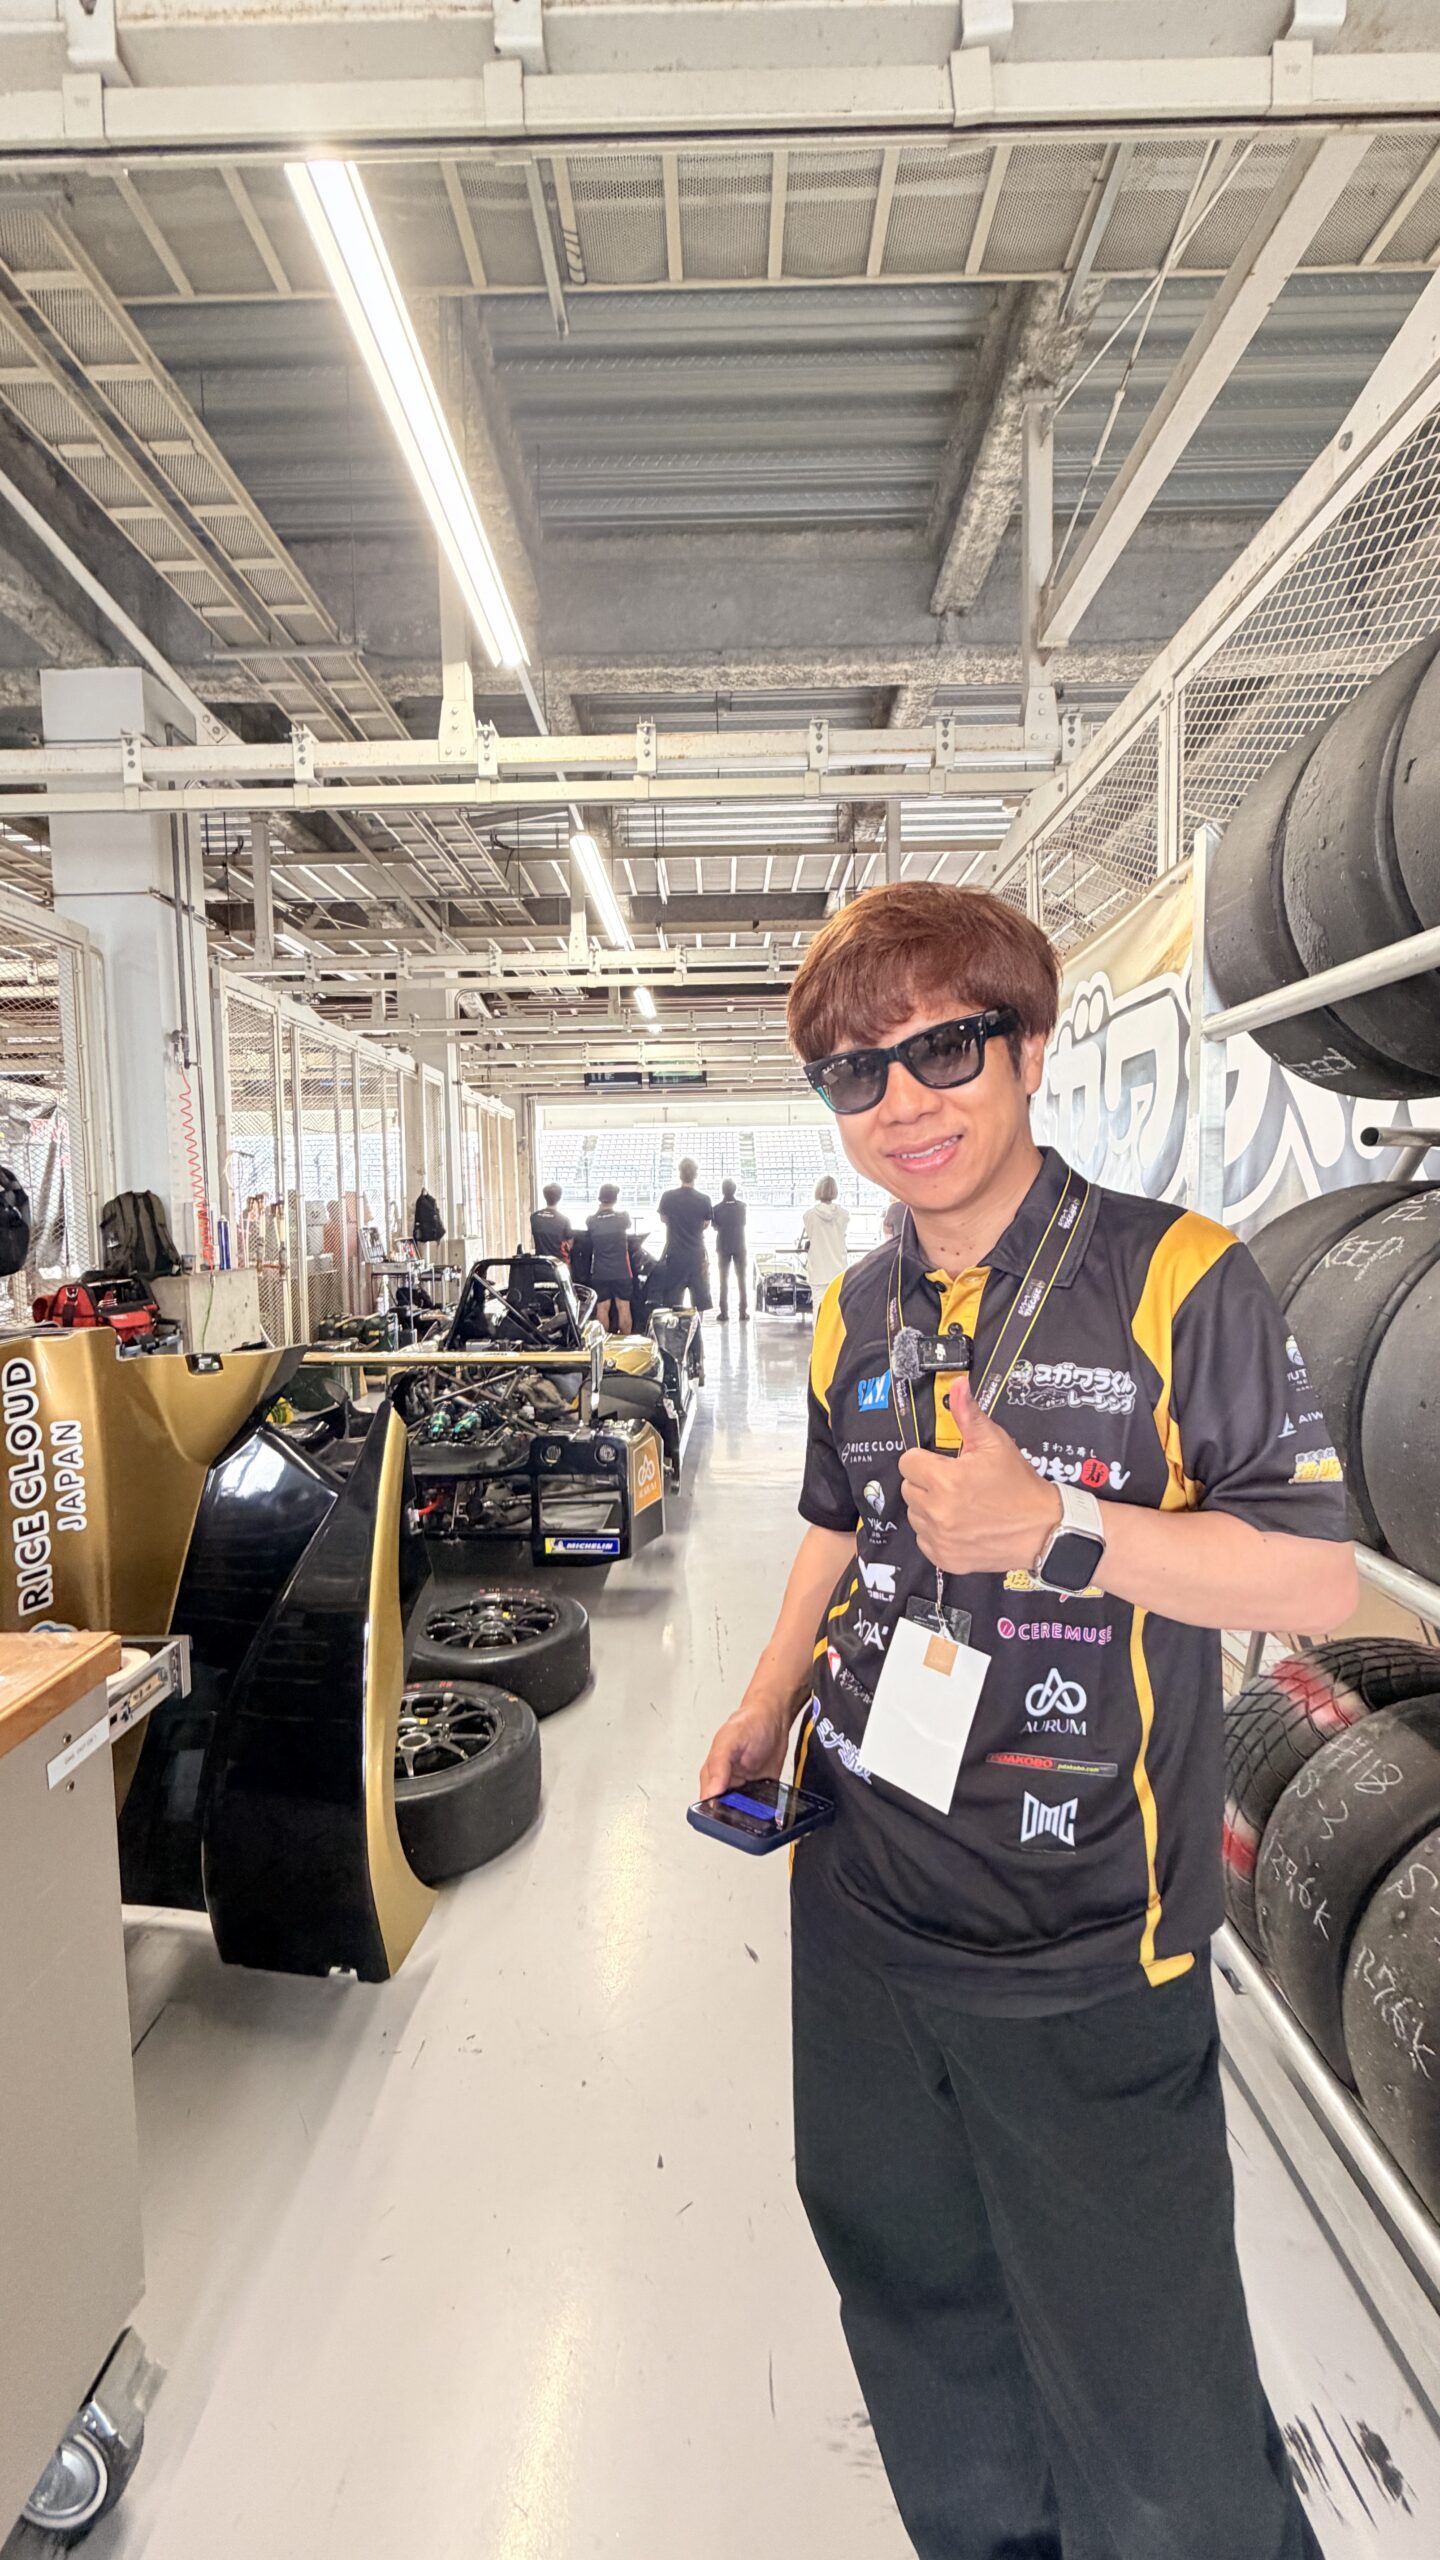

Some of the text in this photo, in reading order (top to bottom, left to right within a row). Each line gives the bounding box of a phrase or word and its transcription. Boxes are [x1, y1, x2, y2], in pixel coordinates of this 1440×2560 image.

[1034, 1363, 1138, 1398] スガワラくん
[1066, 1390, 1136, 1416] レーシング
[850, 1440, 904, 1453] RICE CLOU
[1, 1357, 53, 1616] RICE CLOUD
[50, 1420, 87, 1532] JAPAN
[566, 1541, 613, 1551] MICHELIN
[1018, 1622, 1112, 1645] CEREMUSE
[1020, 1718, 1087, 1736] AURUM
